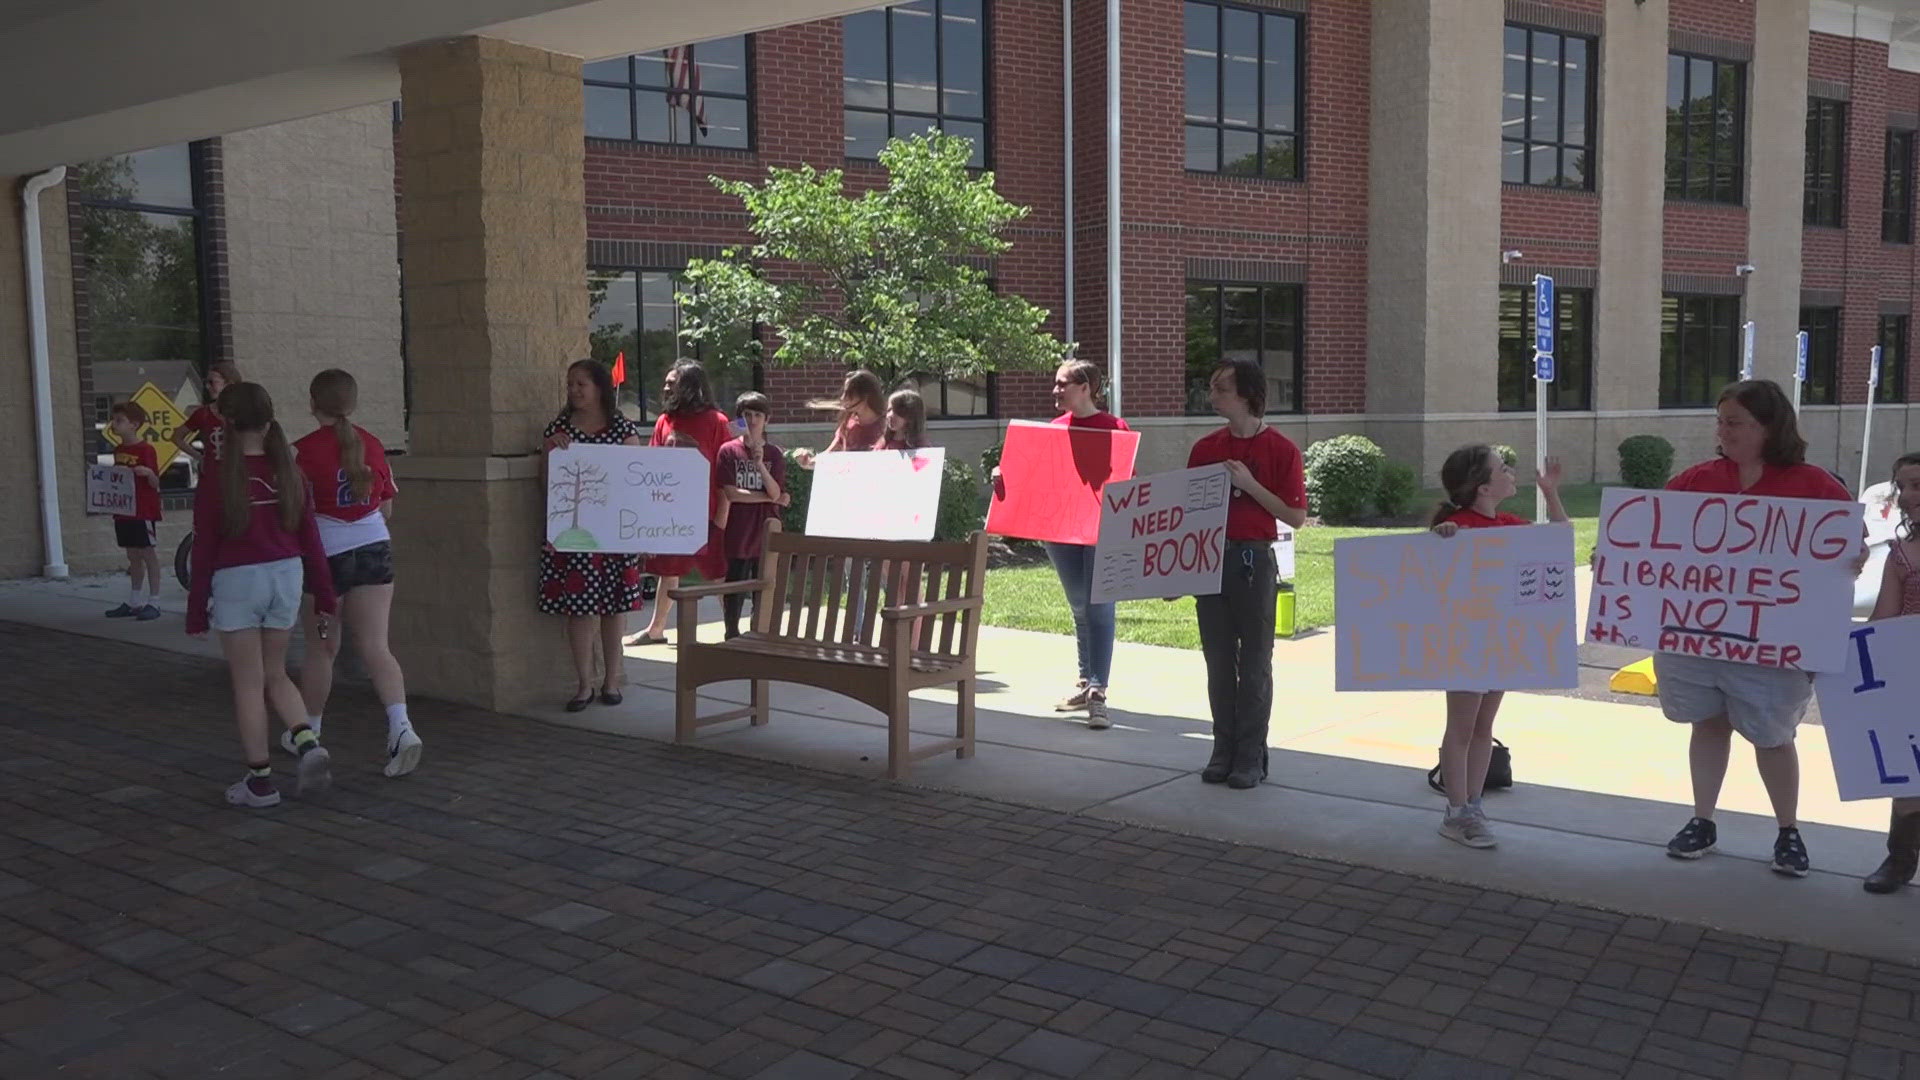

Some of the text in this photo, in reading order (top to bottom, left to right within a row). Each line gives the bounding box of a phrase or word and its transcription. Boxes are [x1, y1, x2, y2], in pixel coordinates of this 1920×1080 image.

[143, 410, 171, 426] AFE
[625, 462, 680, 487] Save
[650, 489, 675, 503] the
[1107, 482, 1152, 514] WE
[92, 491, 133, 511] LIBRARY
[619, 509, 695, 540] Branches
[1131, 505, 1184, 539] NEED
[1606, 495, 1851, 560] CLOSING
[1143, 526, 1223, 577] BOOKS
[1348, 538, 1506, 608] SAVE
[1596, 556, 1801, 605] LIBRARIES
[1598, 594, 1777, 641] IS NOT
[1351, 618, 1566, 683] LIBRARY
[1590, 623, 1802, 670] the ANSWER
[1849, 627, 1886, 694] I
